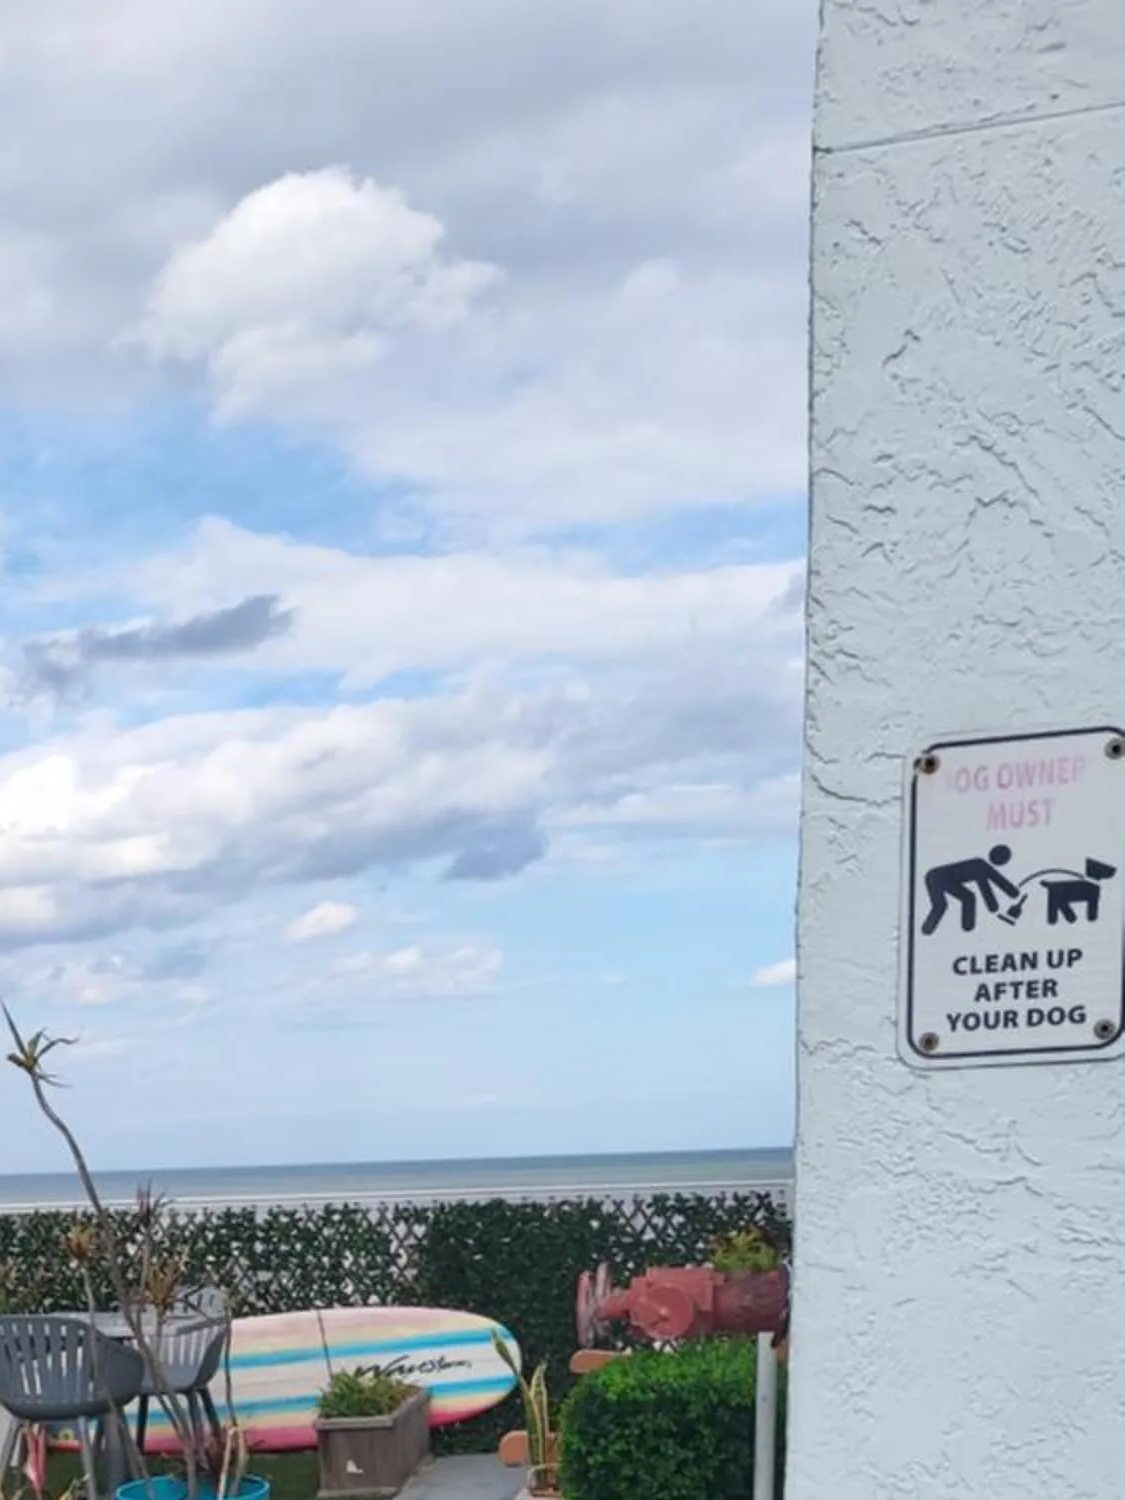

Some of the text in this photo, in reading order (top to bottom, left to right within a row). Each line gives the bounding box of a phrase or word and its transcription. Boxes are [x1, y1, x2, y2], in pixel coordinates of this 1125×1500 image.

[986, 798, 1056, 832] MUST
[952, 948, 1083, 976] CLEAN UP
[973, 978, 1059, 1002] AFTER
[946, 1004, 1087, 1033] YOUR DOG
